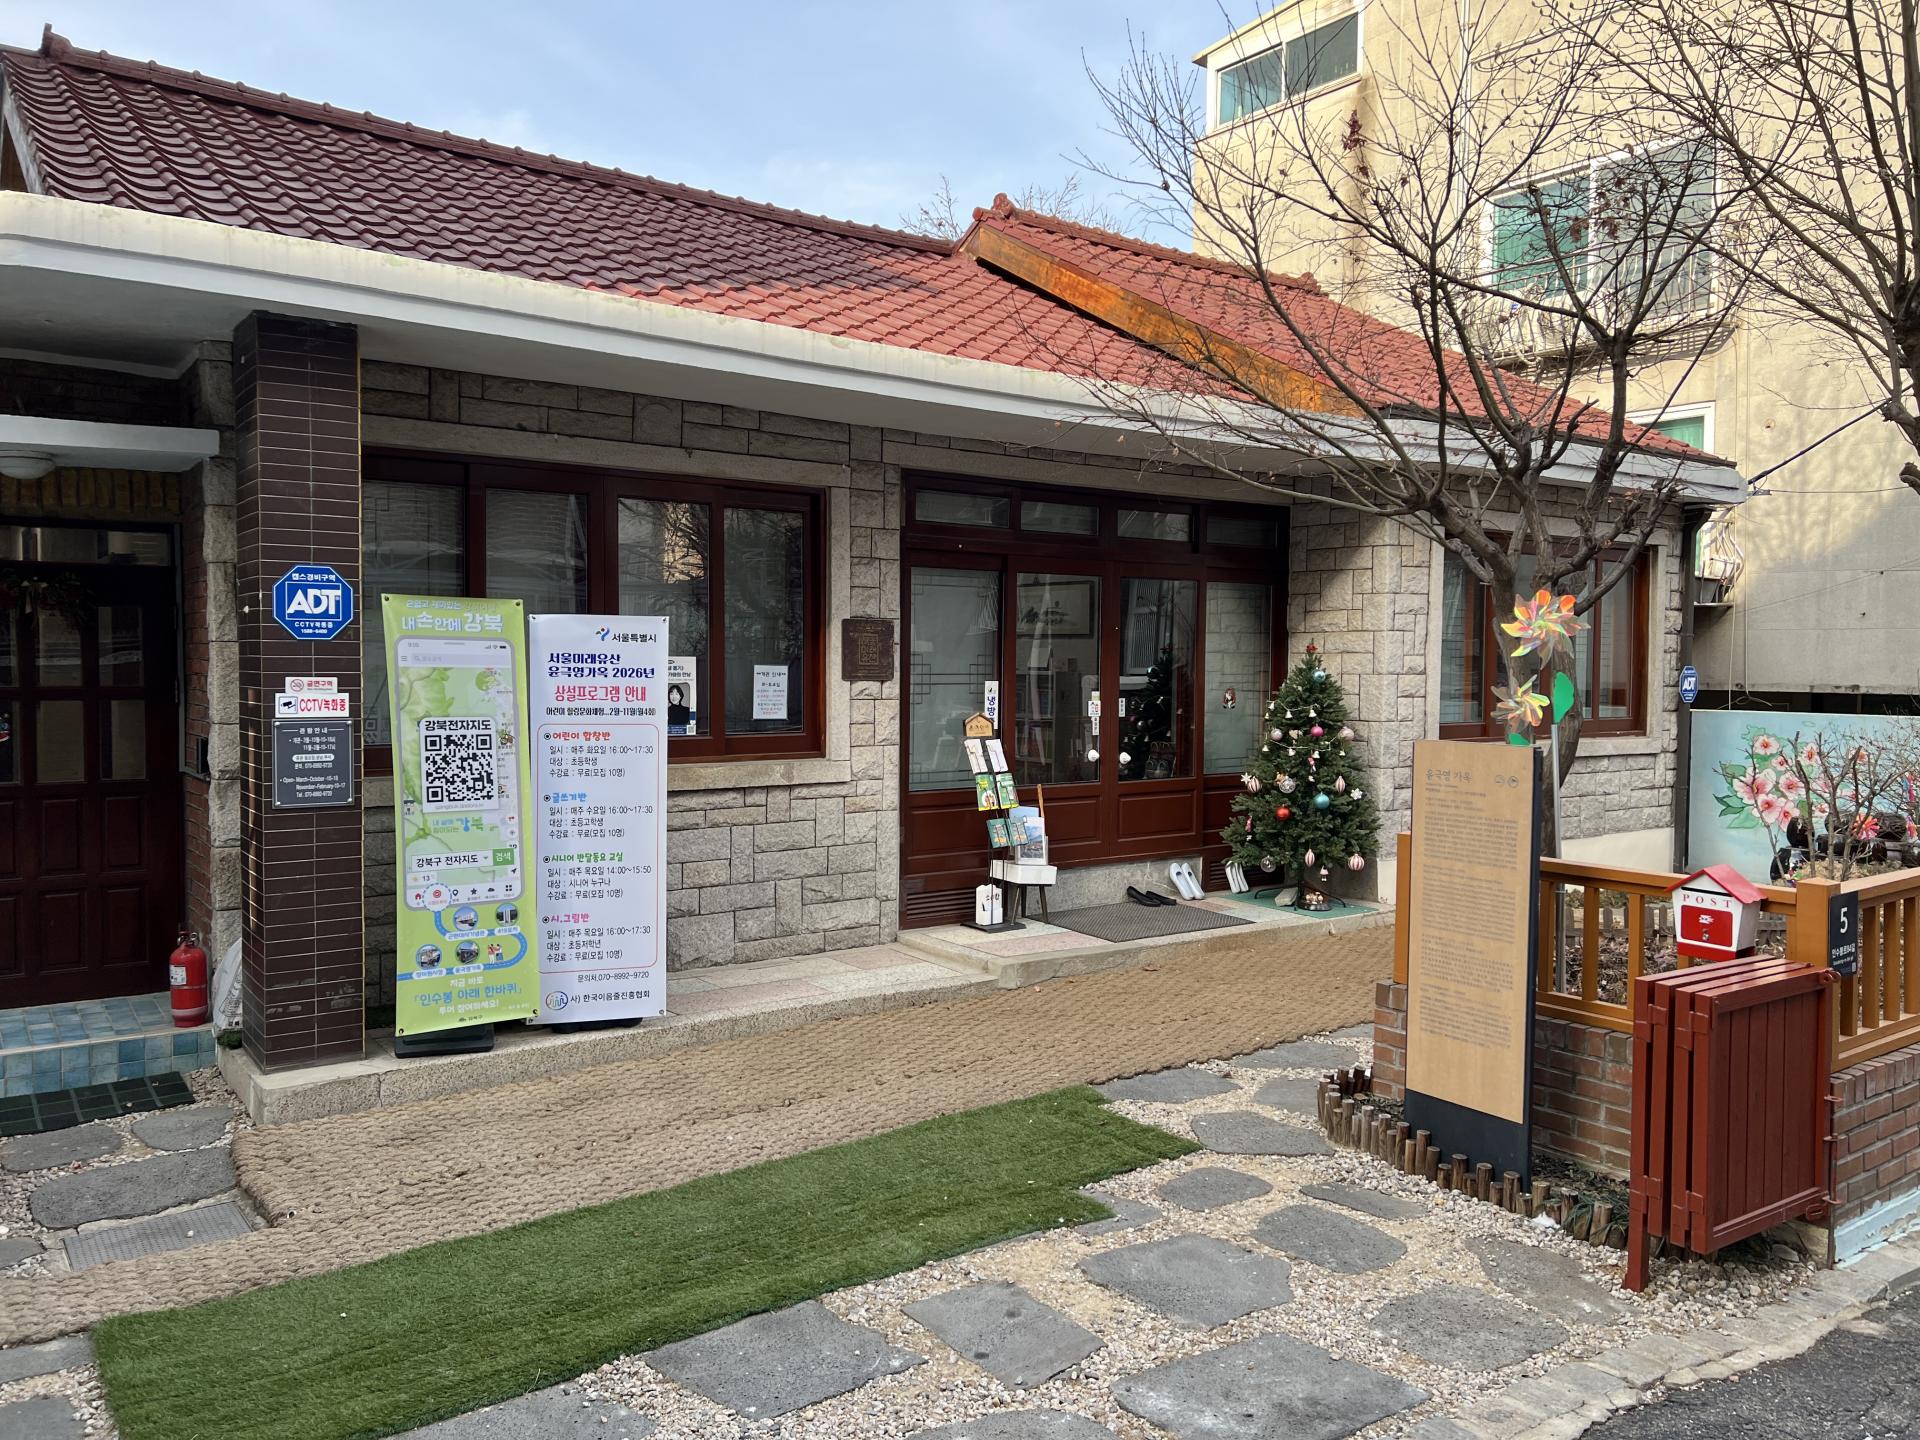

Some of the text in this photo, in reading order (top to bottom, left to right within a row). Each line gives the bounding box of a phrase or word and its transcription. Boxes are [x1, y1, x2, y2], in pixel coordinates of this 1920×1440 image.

[292, 573, 336, 582] 캡스경비구역
[287, 588, 342, 614] ADT
[464, 612, 503, 632] 강북
[612, 633, 657, 642] 서울특별시
[548, 652, 621, 664] 서울미래유산
[548, 666, 608, 678] 윤극영가옥
[612, 667, 655, 678] 2026년
[1682, 677, 1696, 690] ADT
[555, 685, 646, 702] 상설프로그램 안내
[546, 707, 566, 716] 어린이
[425, 720, 492, 731] 강북전자지도
[552, 732, 611, 741] 어린이 합창반
[550, 746, 562, 754] 일시
[571, 746, 584, 754] 매주
[586, 746, 606, 754] 화요일
[610, 746, 654, 754] 16:00~17:30
[550, 757, 562, 766] 대상
[571, 757, 598, 766] 초등학생
[550, 768, 570, 778] 수강료
[578, 768, 606, 777] 무료(모집
[608, 768, 626, 777] 10명)
[552, 792, 587, 804] 글쓰기반
[550, 807, 562, 816] 일시
[571, 807, 584, 815] 매주
[587, 806, 606, 814] 수요일
[609, 806, 653, 814] 16:00~17:30
[550, 818, 562, 828] 대상
[549, 830, 568, 840] 수강료
[577, 829, 606, 838] 무료(모집
[608, 828, 625, 838] 10명)
[416, 854, 478, 868] 강북구 전자지도
[496, 852, 511, 862] 검색
[551, 852, 623, 863] 시니어 반달동요 교실
[548, 868, 560, 878] 일시
[569, 868, 582, 876] 매주
[584, 866, 604, 875] 목요일
[607, 866, 652, 874] 14:00~15:50
[548, 880, 560, 888] 대상
[569, 878, 588, 888] 시니어
[591, 878, 610, 886] 누구나
[547, 891, 567, 900] 수강료
[576, 890, 604, 899] 무료(모집
[607, 888, 623, 898] 10명)
[1682, 894, 1732, 908] POST
[1840, 906, 1848, 934] 5
[547, 930, 560, 940] 일시
[569, 929, 582, 938] 매주
[584, 928, 604, 937] 목요일
[607, 926, 651, 936] 16:00~17:30
[547, 942, 560, 951] 대상
[547, 953, 566, 963] 수강료
[575, 951, 604, 960] 무료(모집
[606, 950, 623, 959] 10명)
[458, 988, 480, 998] 아래
